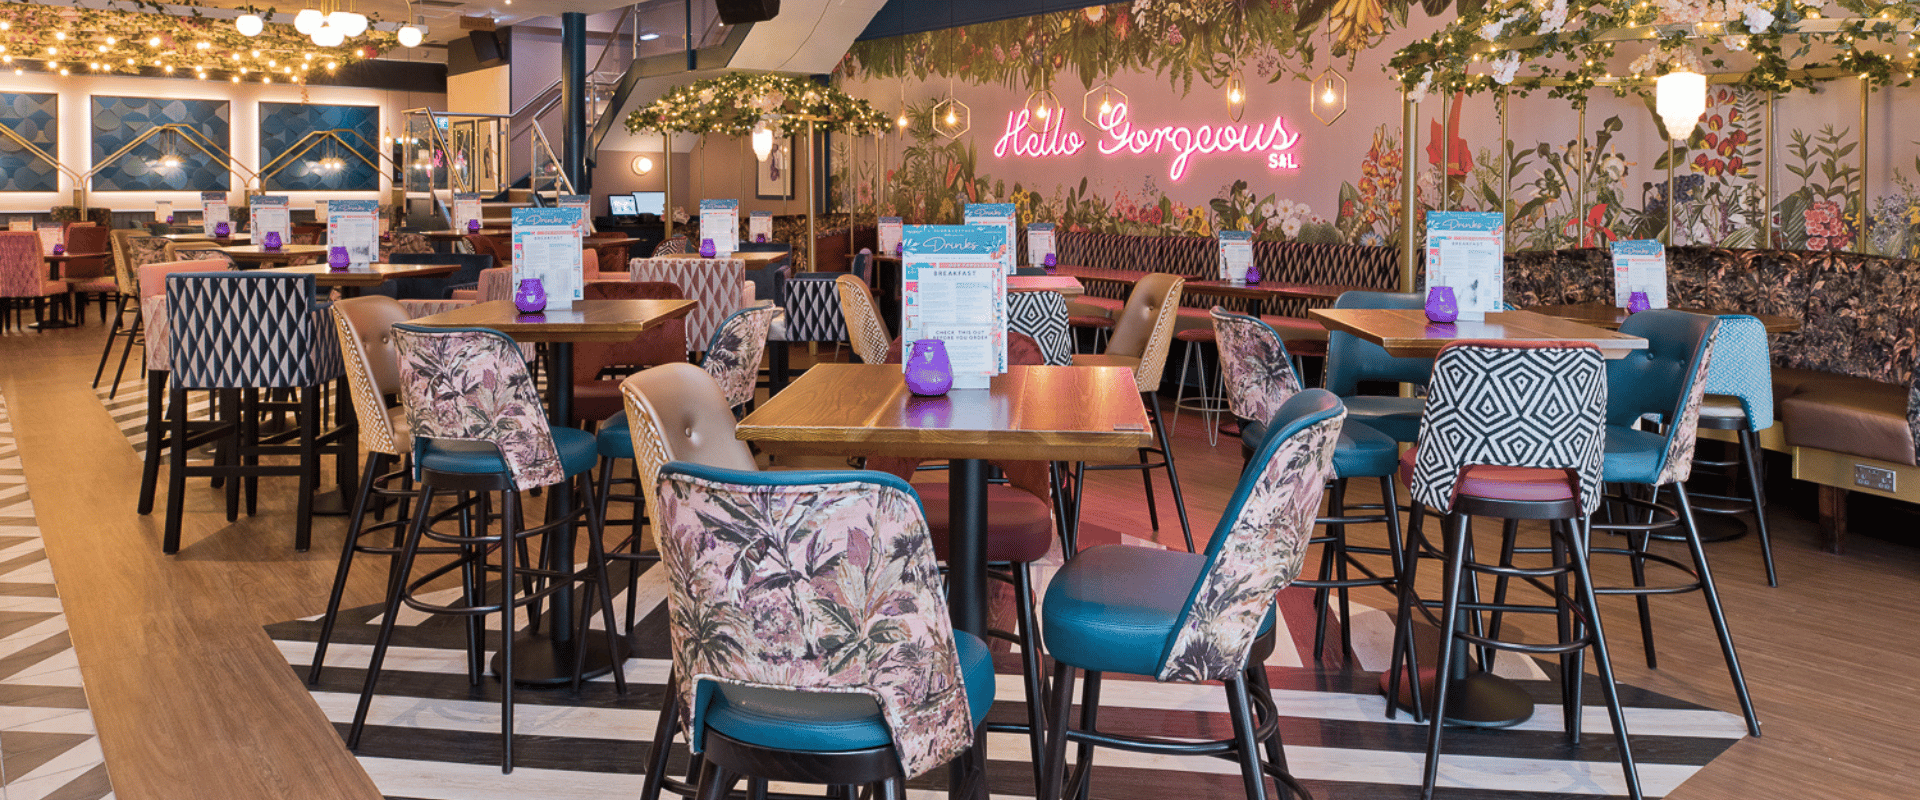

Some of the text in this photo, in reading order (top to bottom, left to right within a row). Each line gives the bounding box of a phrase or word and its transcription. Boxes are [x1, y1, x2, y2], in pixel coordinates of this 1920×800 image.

[994, 102, 1298, 180] Hello Gorgeous
[1443, 219, 1483, 231] Drinks
[922, 236, 979, 252] Drinks
